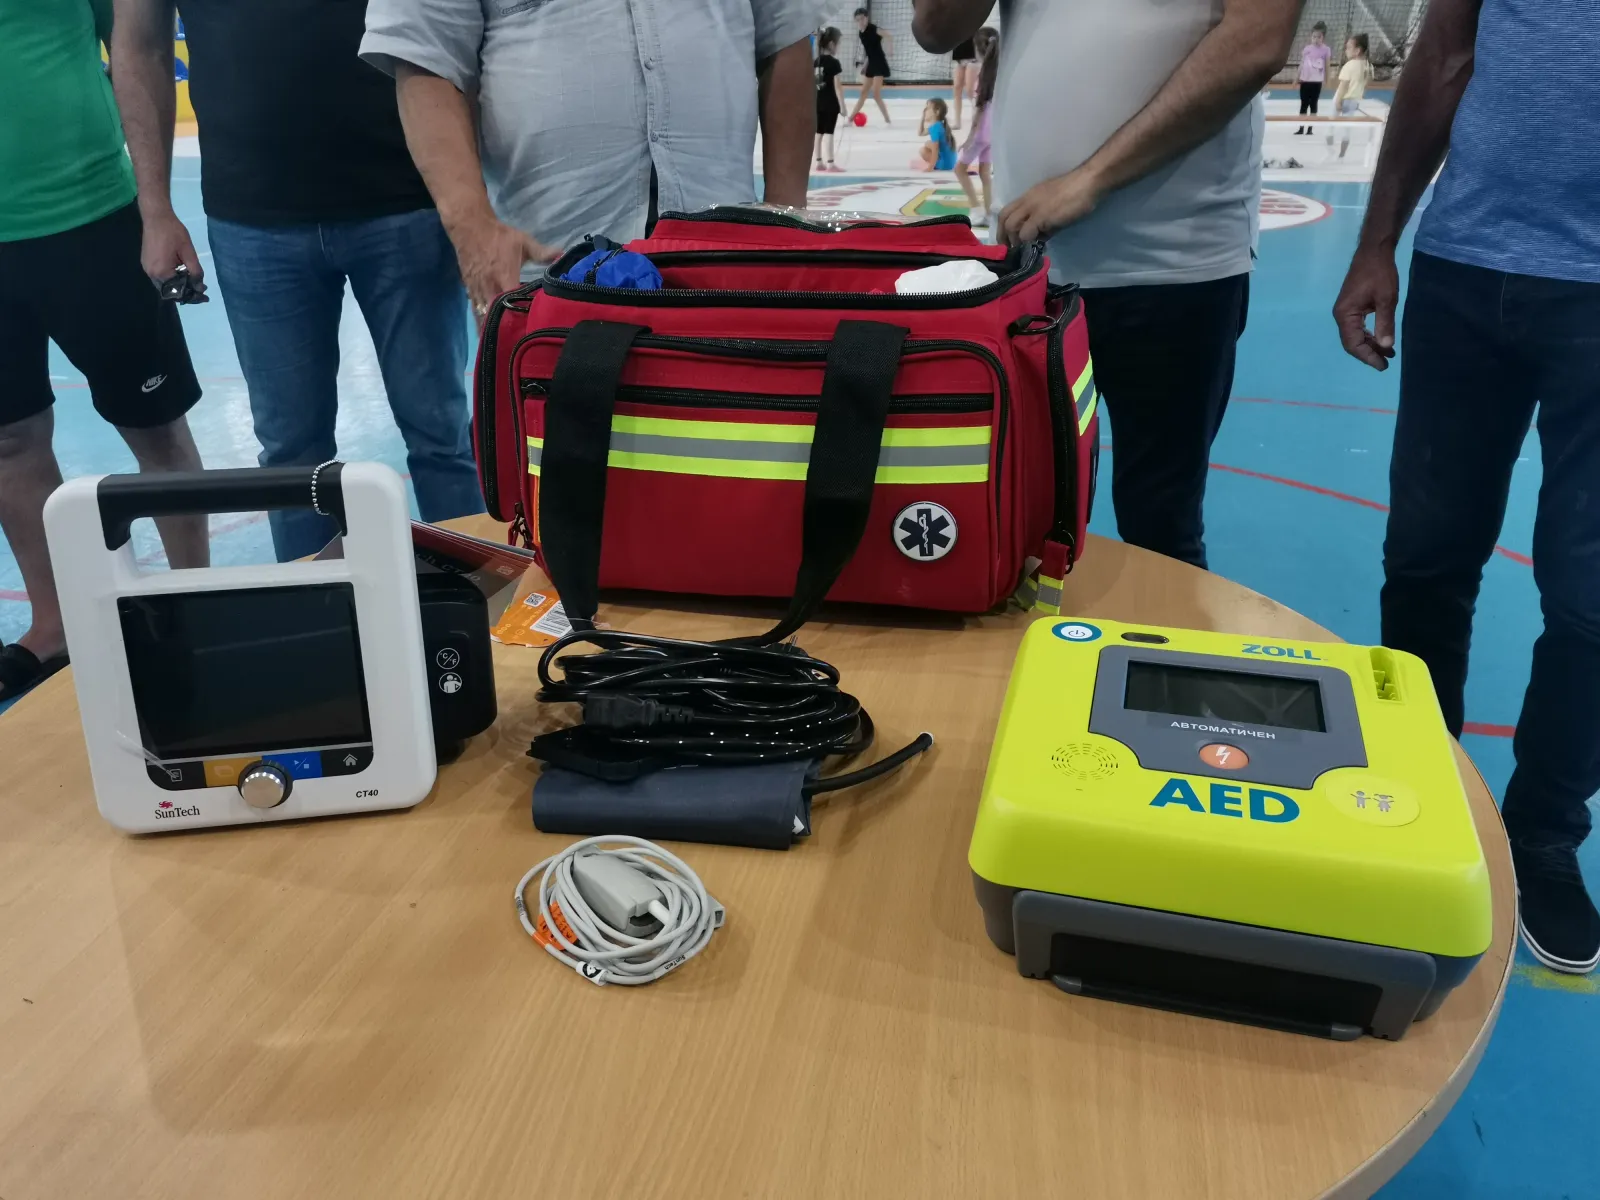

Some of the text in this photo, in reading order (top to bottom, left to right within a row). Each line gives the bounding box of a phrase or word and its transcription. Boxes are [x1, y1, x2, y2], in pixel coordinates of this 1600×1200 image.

[1241, 643, 1321, 661] ZOLL
[1170, 721, 1276, 740] АВТОМАТИЧЕН
[355, 789, 379, 798] CT40
[1149, 777, 1301, 823] AED
[154, 805, 200, 819] SunTech
